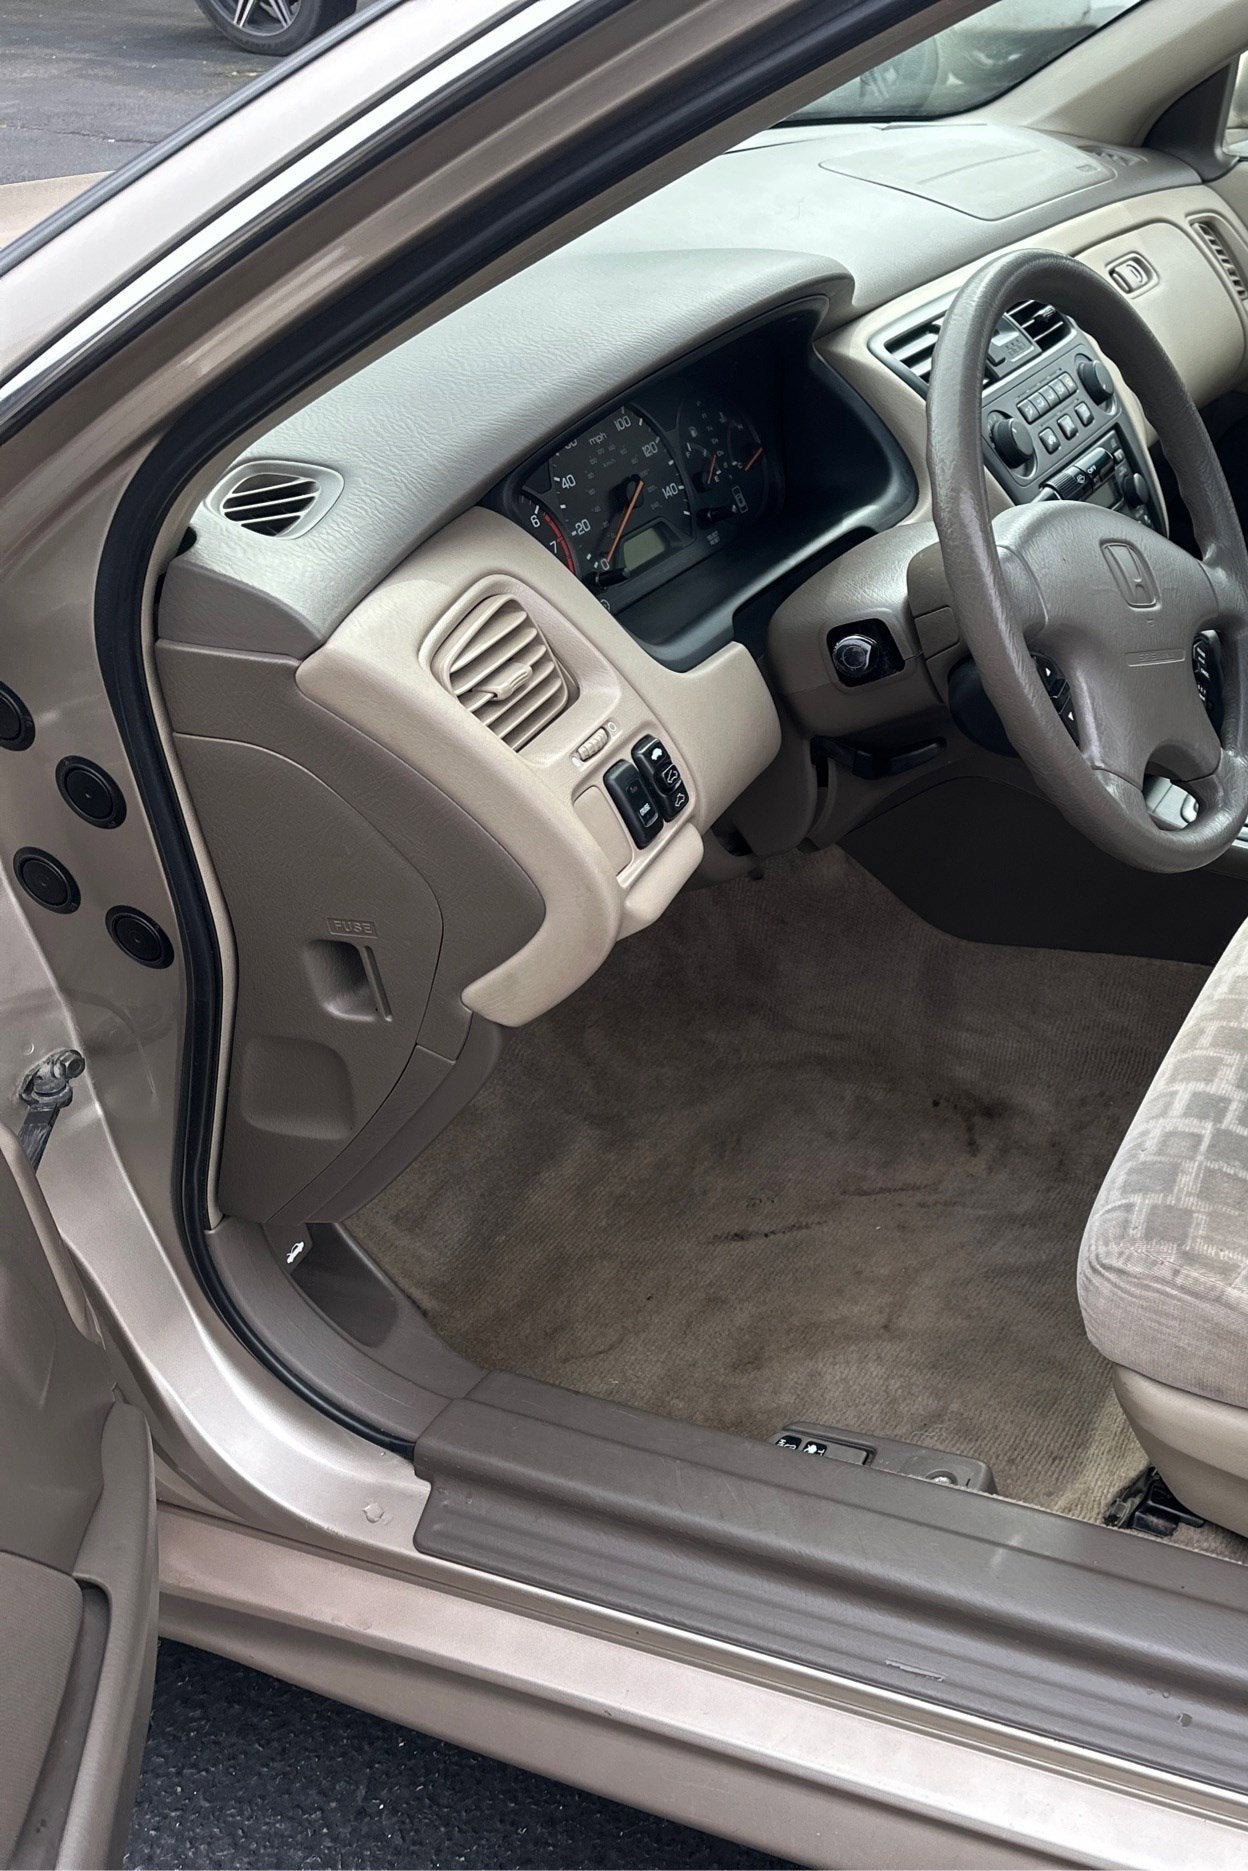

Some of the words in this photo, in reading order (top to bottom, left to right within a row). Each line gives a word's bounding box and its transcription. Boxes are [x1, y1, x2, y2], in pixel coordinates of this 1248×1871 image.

[614, 415, 631, 431] 100
[589, 432, 607, 445] mph
[642, 441, 658, 457] 120
[561, 474, 576, 489] 40
[662, 482, 678, 499] 140
[530, 514, 540, 528] 6
[575, 518, 591, 535] 20
[549, 540, 557, 554] 7
[600, 558, 609, 571] 0
[334, 920, 373, 934] FUSE
